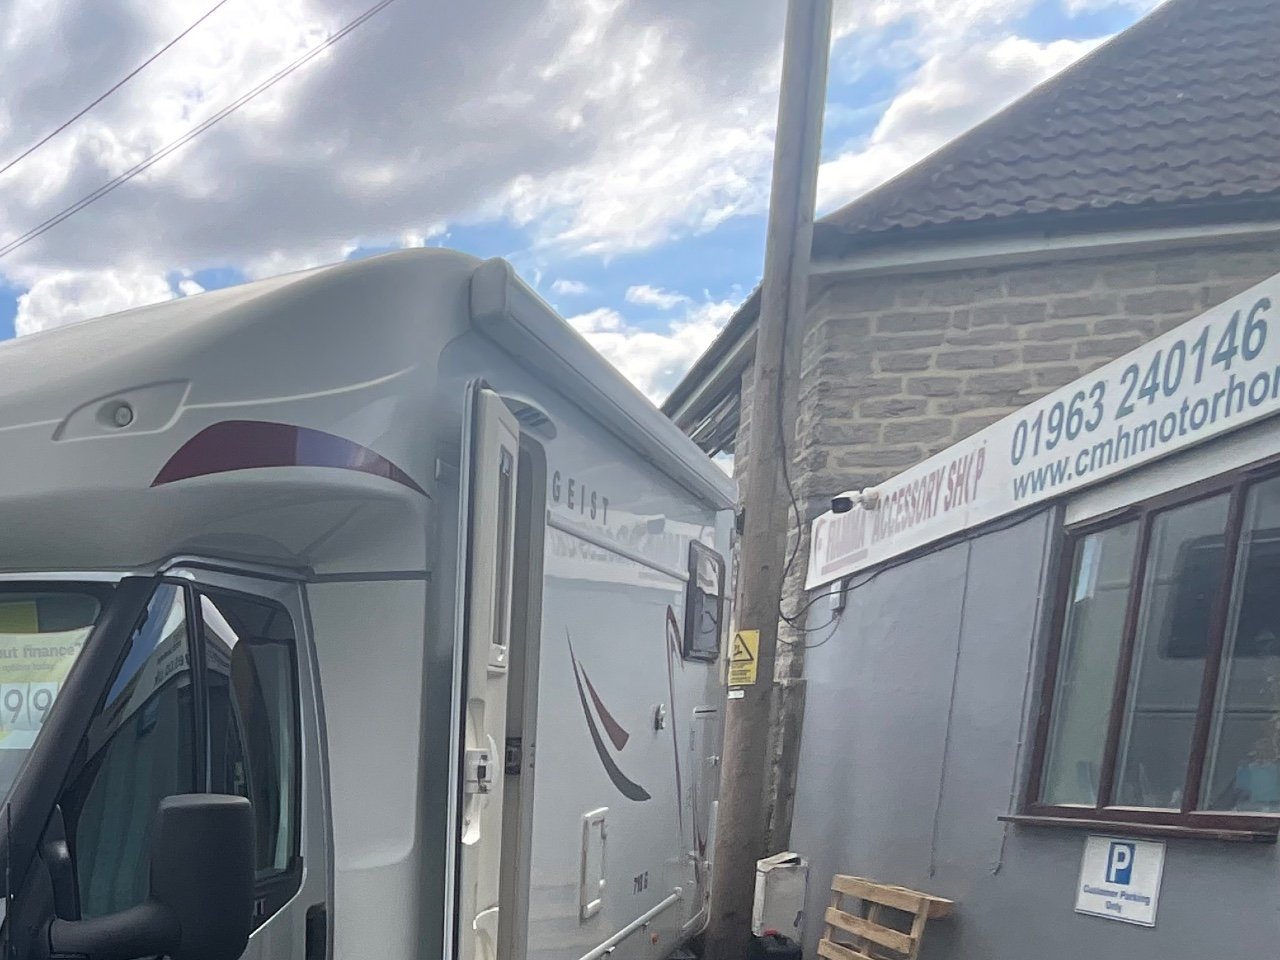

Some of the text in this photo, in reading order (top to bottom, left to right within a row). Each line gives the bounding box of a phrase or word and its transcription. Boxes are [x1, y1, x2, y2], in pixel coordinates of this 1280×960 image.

[1010, 297, 1273, 467] 01963 240146
[552, 470, 609, 526] GEIST
